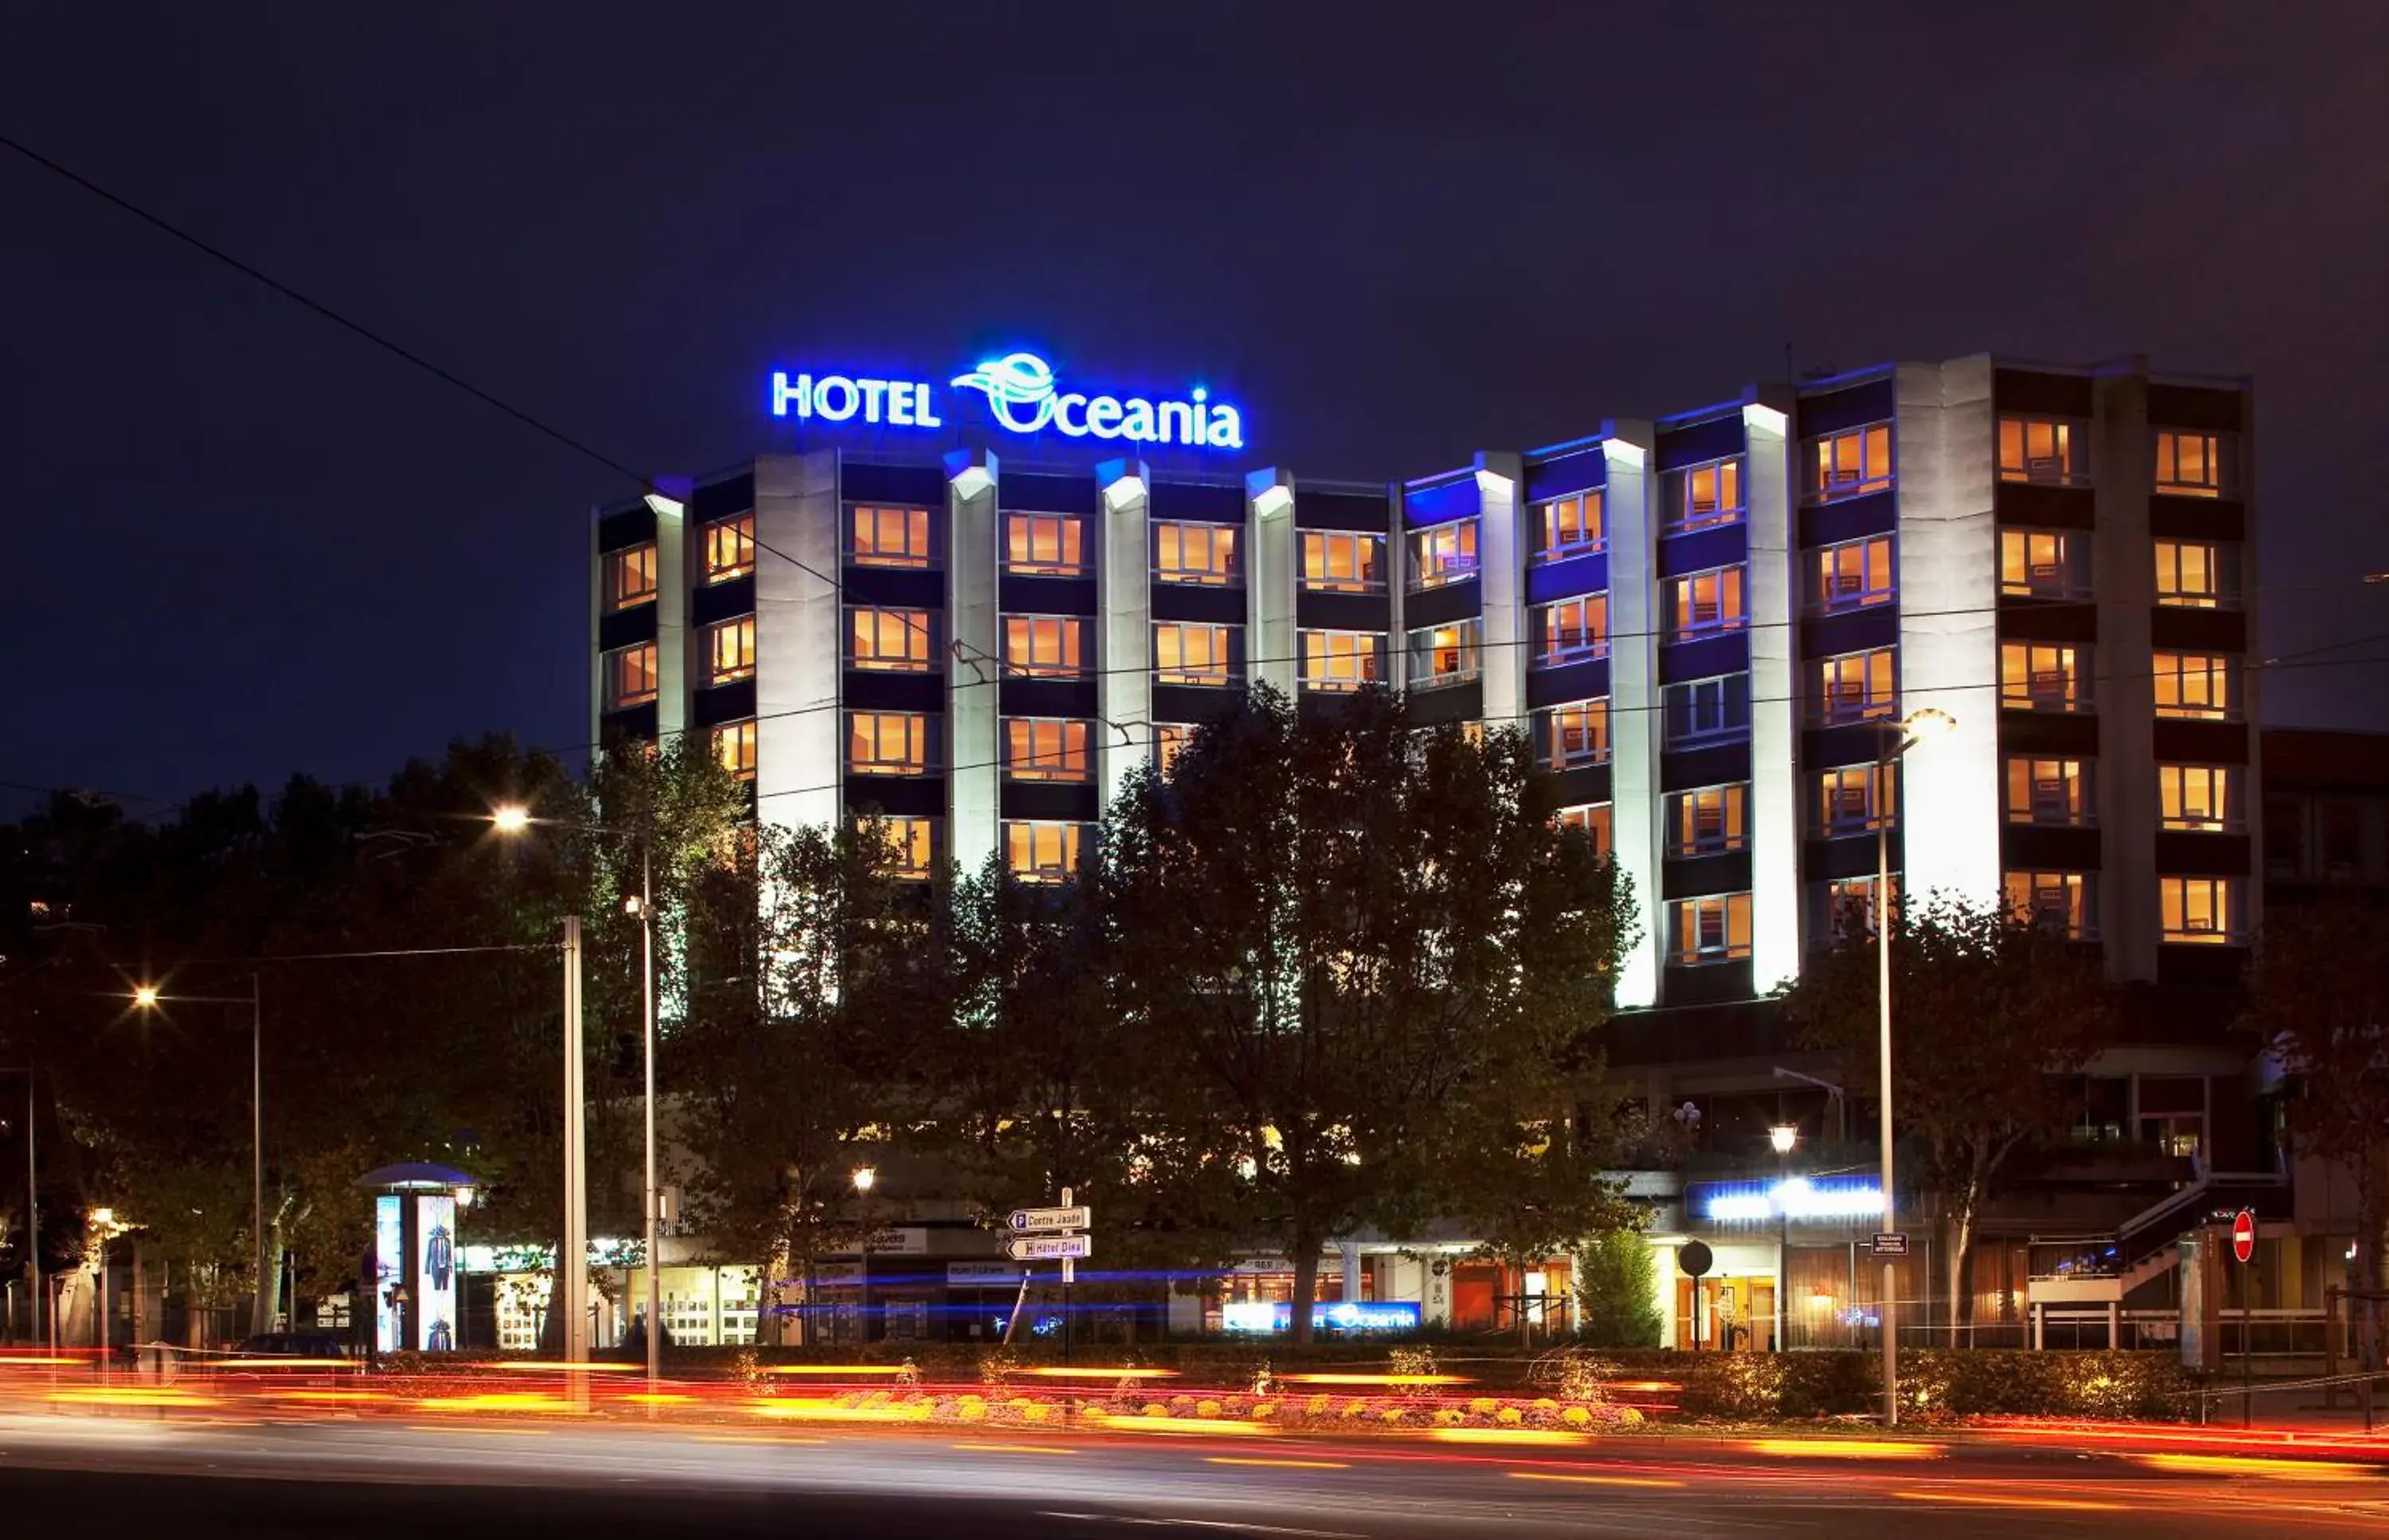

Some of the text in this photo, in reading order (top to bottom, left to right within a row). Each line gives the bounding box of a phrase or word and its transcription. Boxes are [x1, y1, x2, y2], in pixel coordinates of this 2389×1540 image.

[772, 353, 1244, 448] HOTEL Oceania
[1018, 1215, 1025, 1226] P
